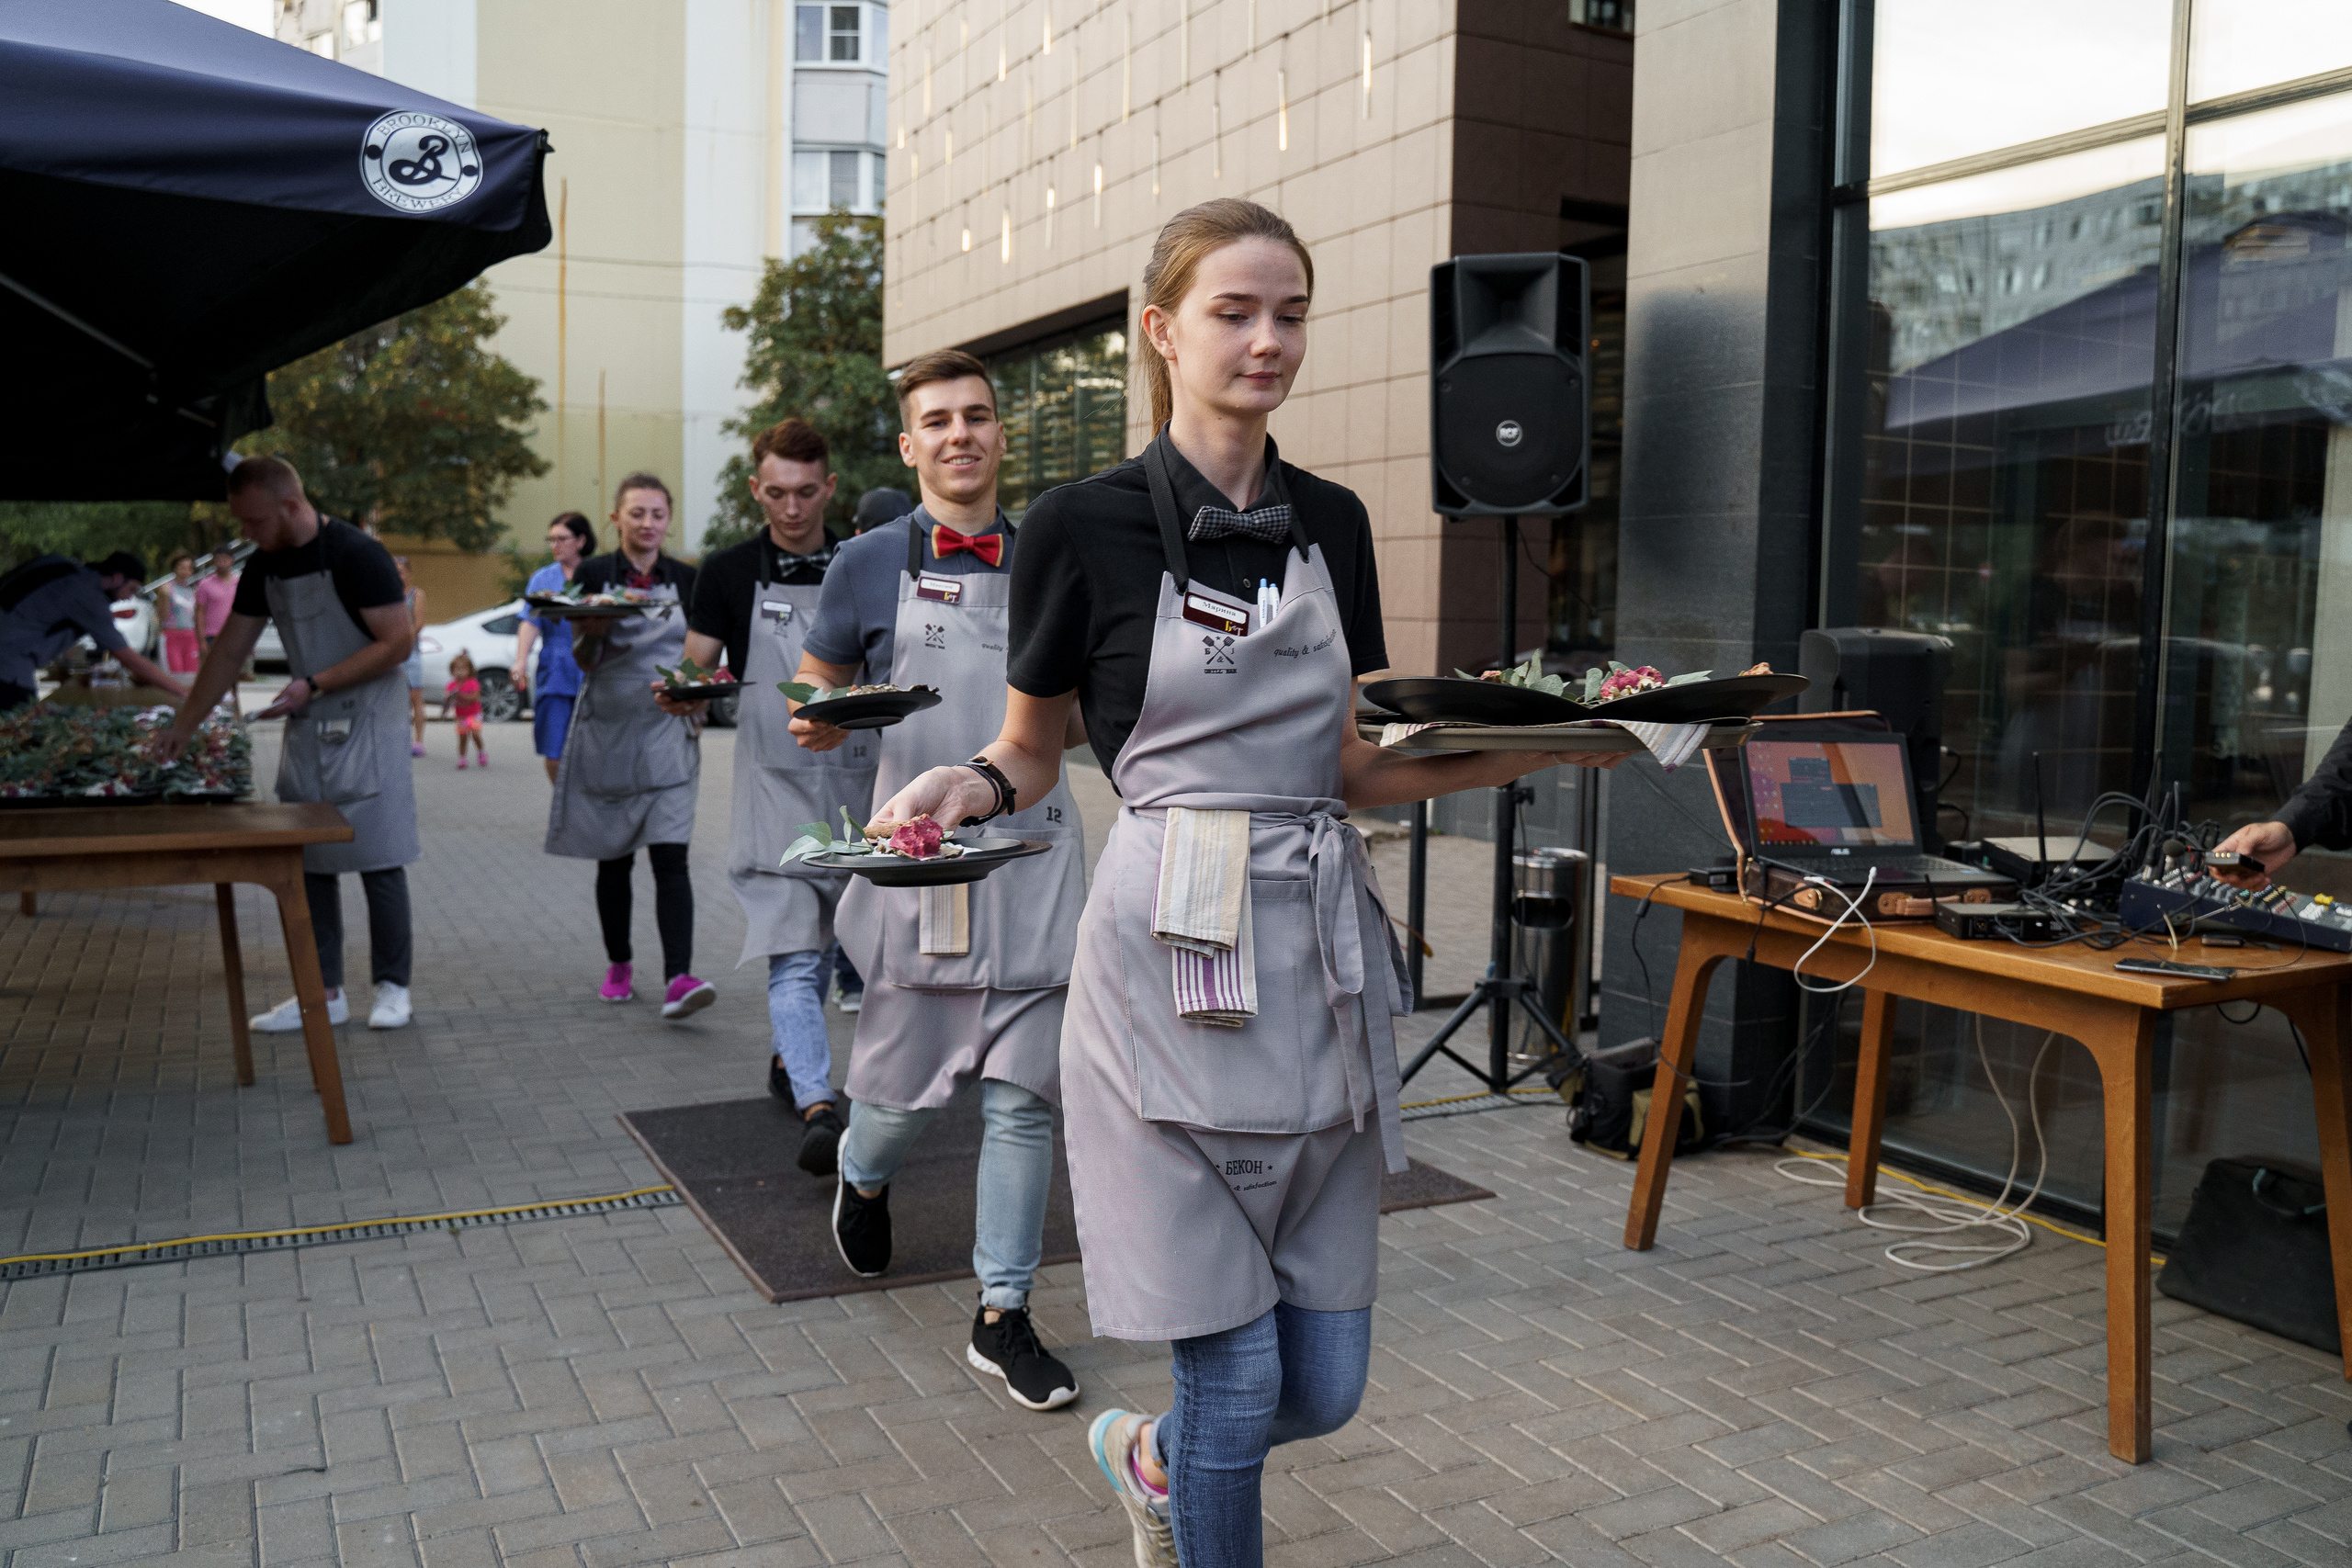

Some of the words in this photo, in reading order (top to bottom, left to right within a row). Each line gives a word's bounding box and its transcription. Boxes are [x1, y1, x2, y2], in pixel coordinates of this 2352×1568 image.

[377, 114, 471, 153] BROOKLYN
[373, 178, 464, 209] BREWERY
[1499, 427, 1520, 439] RCF
[1202, 601, 1237, 616] Марина
[981, 643, 1003, 652] quality
[1273, 647, 1299, 659] quality
[1302, 644, 1310, 655] &
[1046, 806, 1062, 824] 12
[1226, 1159, 1263, 1175] БЕКОН
[1243, 1180, 1278, 1191] satisfaction
